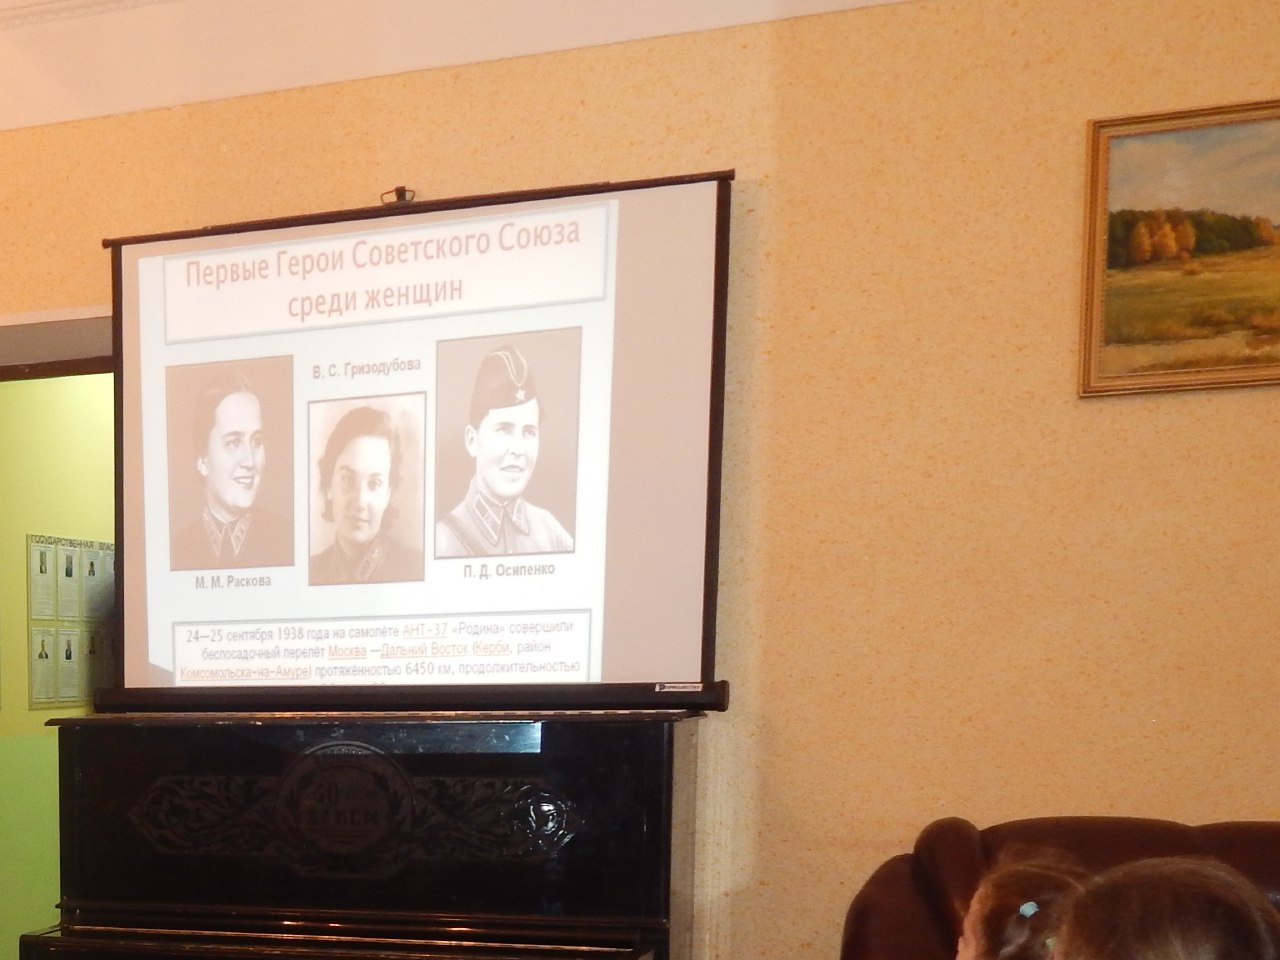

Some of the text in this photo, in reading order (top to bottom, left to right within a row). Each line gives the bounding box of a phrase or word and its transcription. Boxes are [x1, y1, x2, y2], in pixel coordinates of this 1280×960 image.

[186, 221, 581, 290] Первые Герои Советского Союза
[288, 279, 463, 322] среди женщин
[312, 357, 421, 380] В. С. Гризодубова
[30, 534, 94, 550] ГОСУДАРСТВЕННАЯ
[463, 563, 556, 580] П. Д. Осипенко
[195, 575, 272, 590] М. М. Раскова
[226, 628, 273, 645] сентября
[278, 626, 305, 641] 1938
[306, 627, 330, 641] года
[332, 627, 346, 639] на
[349, 625, 400, 640] самолёте
[403, 622, 449, 637] АНТ-37
[452, 621, 505, 636] «Родина»
[509, 620, 574, 636] совершили
[202, 646, 281, 661] беспосадочный
[283, 645, 325, 660] перелёт
[328, 645, 367, 658] Москва
[431, 641, 468, 656] Восток
[516, 640, 552, 655] район
[315, 663, 402, 679] протяжённостью
[405, 661, 435, 676] 6450
[458, 660, 581, 676] продолжительностью
